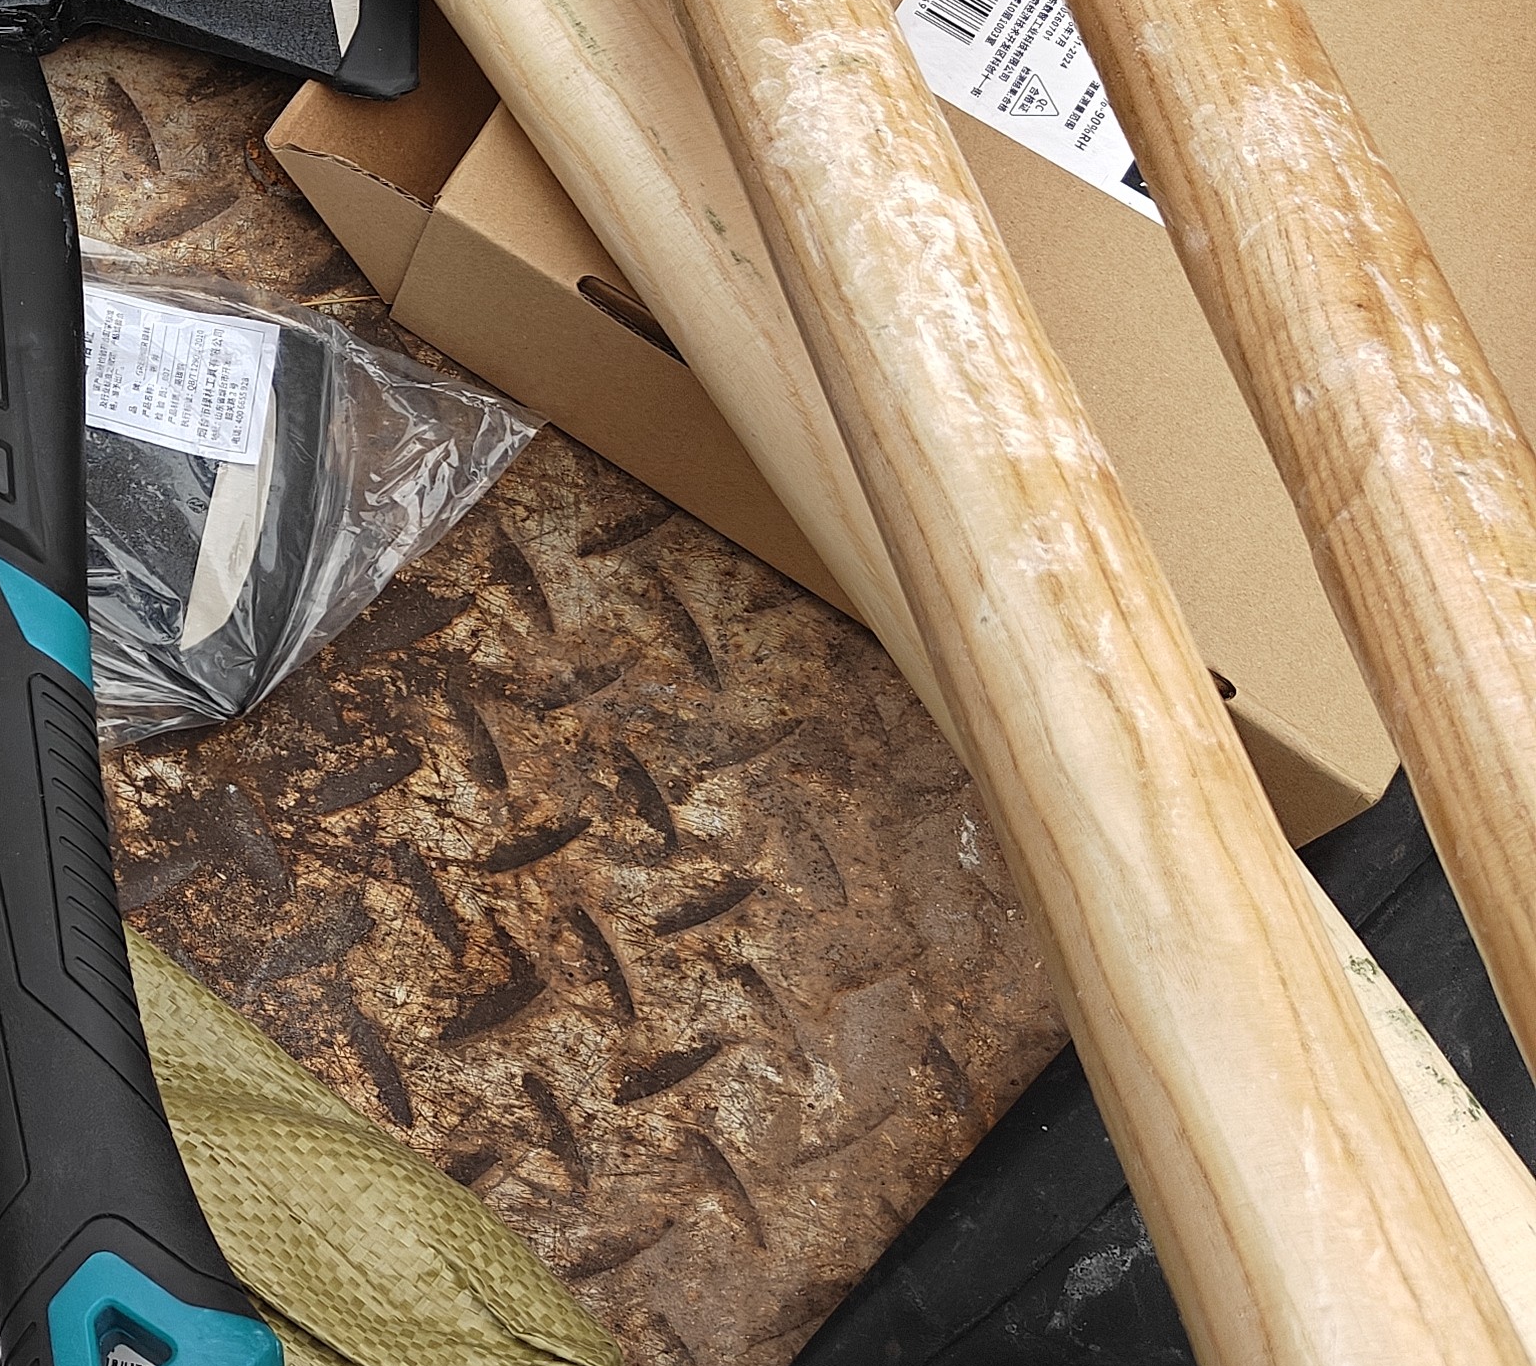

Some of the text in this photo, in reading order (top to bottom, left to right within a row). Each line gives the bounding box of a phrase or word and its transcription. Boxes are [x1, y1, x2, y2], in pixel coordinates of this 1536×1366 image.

[1018, 87, 1039, 112] 合格证
[1035, 99, 1047, 112] QC
